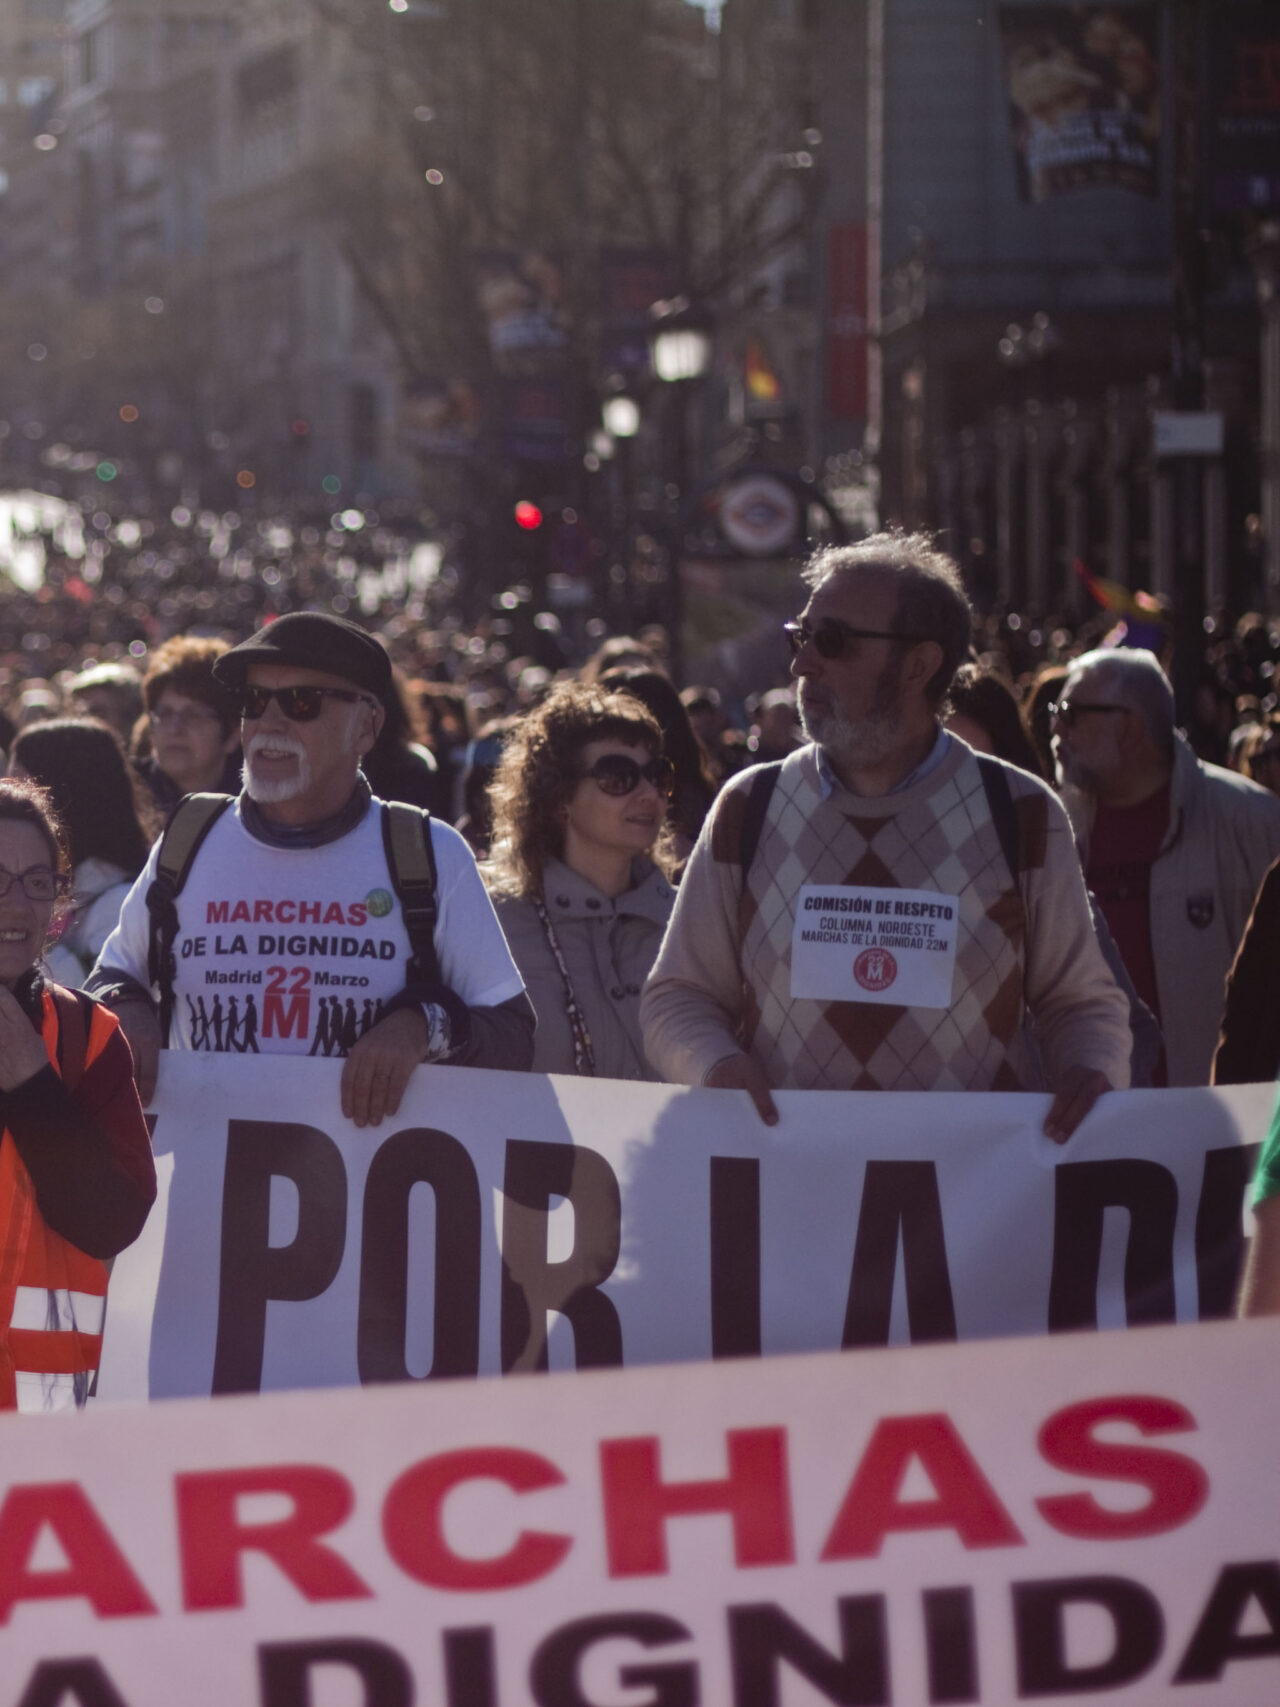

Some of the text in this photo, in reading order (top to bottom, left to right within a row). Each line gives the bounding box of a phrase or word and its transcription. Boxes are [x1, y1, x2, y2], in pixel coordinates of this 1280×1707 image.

[206, 900, 368, 926] MARCHAS
[804, 895, 953, 920] COMISIÓN DE RESPETO
[820, 916, 936, 937] COLUMNA NOROESTE
[181, 935, 396, 960] DE LA DIGNIDAD
[801, 930, 948, 952] MARCHAS DE LA DIGNIDAD 22M
[205, 965, 369, 995] Madrid 22 Marzo
[261, 993, 310, 1040] M
[210, 1118, 624, 1399] POR
